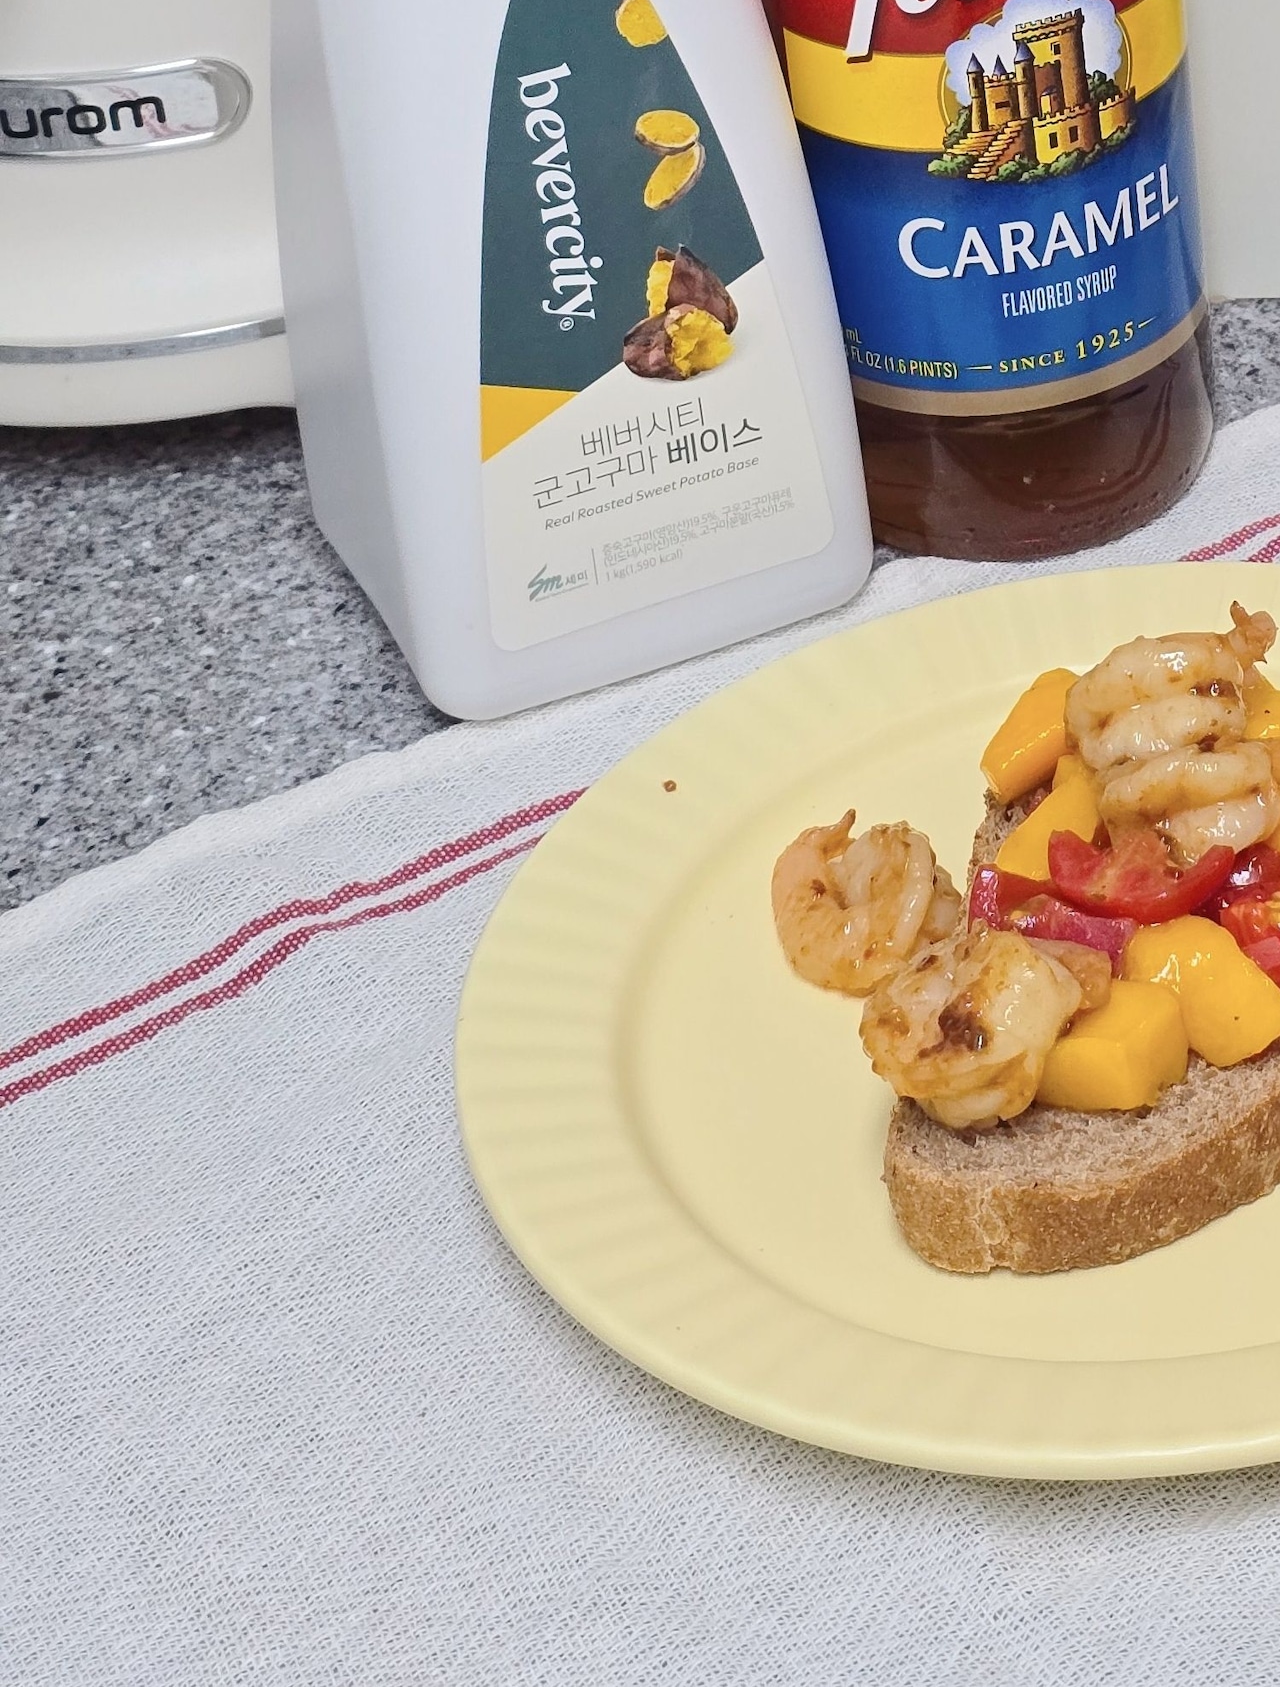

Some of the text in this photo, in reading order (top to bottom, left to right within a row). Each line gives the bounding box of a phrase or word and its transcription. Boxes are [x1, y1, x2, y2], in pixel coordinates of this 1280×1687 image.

[0, 95, 167, 139] urom
[897, 163, 1181, 280] CARAMEL
[1002, 264, 1118, 319] FLAVORED SYRUP
[850, 345, 864, 364] FL
[866, 350, 882, 370] OZ
[909, 359, 959, 381] PINTS)
[999, 320, 1134, 374] SINCE 1925
[580, 396, 705, 457] 베버시티
[532, 417, 763, 509] 군고구마 베이스
[544, 455, 760, 531] Real Roasted Sweet Potato Base
